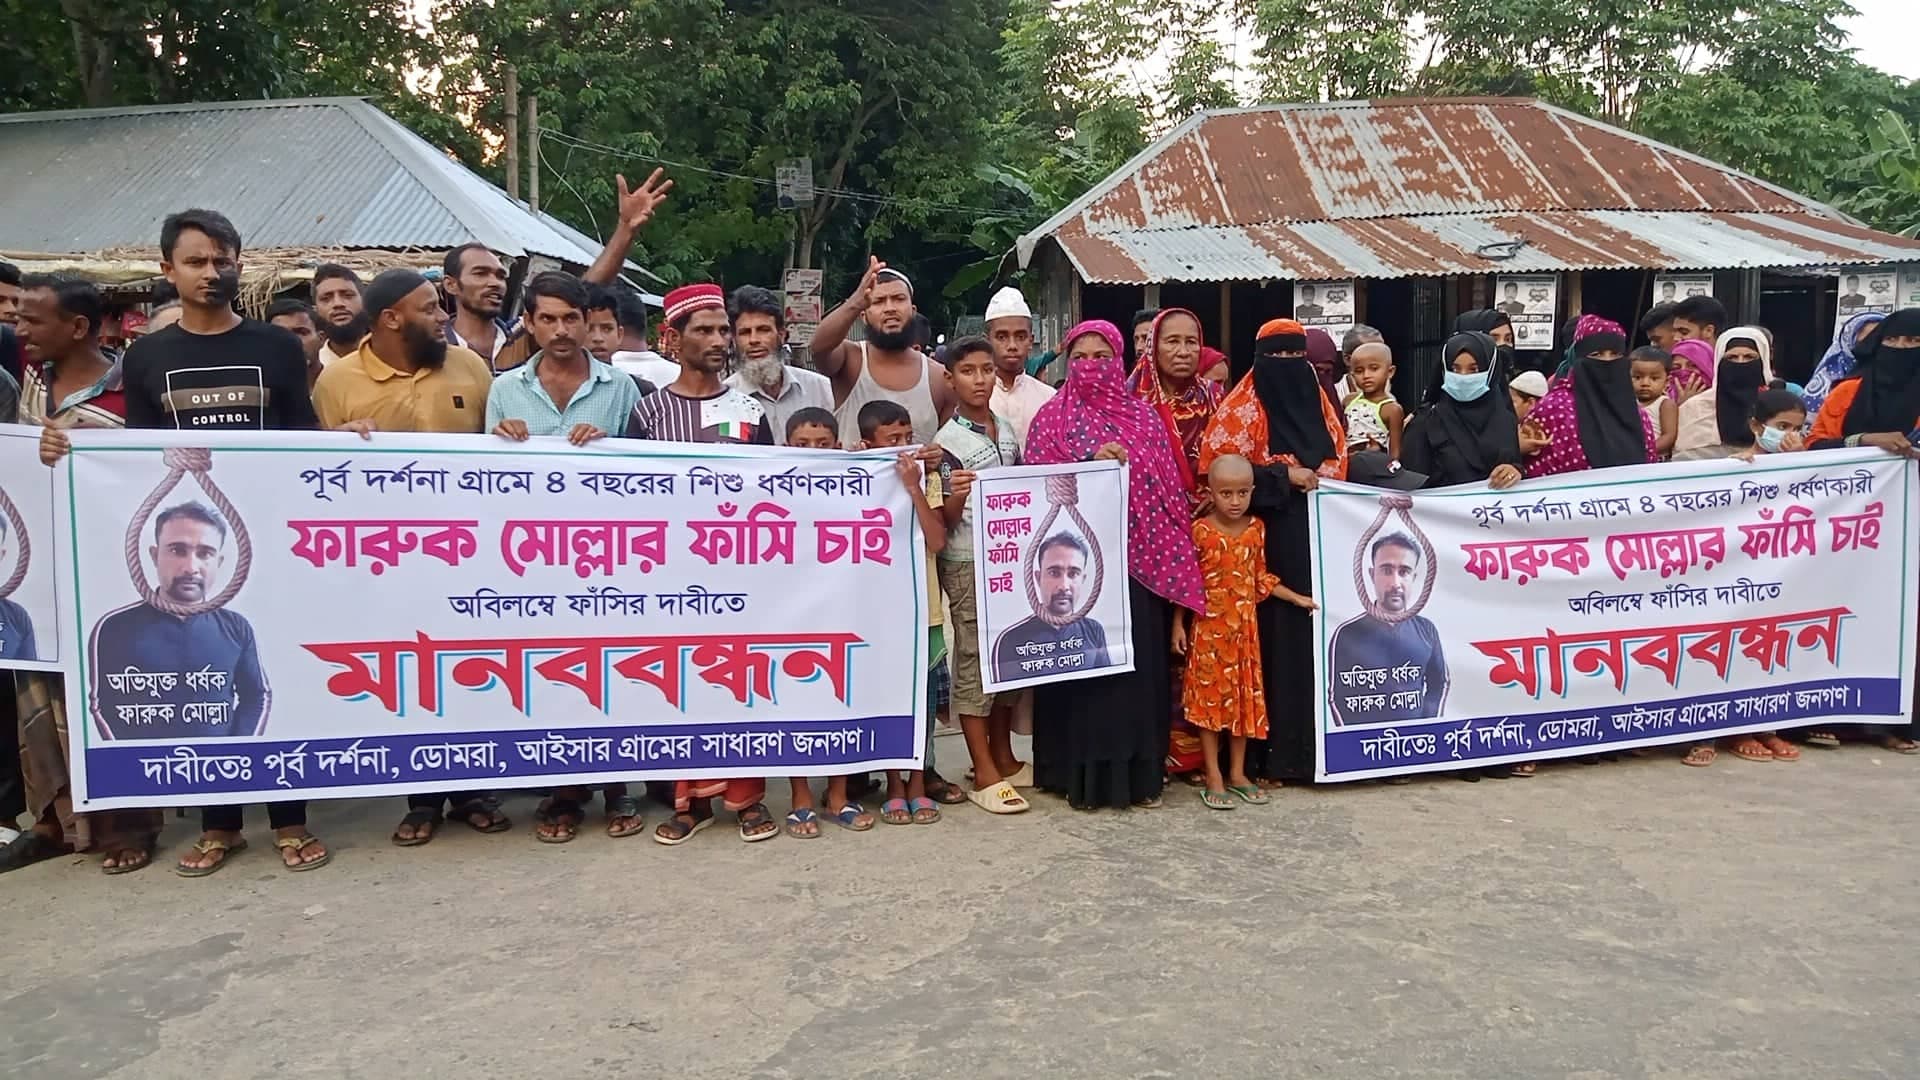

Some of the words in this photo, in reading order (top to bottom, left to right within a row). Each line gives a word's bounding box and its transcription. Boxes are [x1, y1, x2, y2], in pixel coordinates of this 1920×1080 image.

[191, 393, 221, 404] OUT
[227, 391, 245, 401] OF
[192, 413, 250, 425] CONTROL
[299, 460, 352, 502] পূর্ব
[360, 460, 451, 494] দর্শনা
[457, 468, 535, 495] গ্রামে
[546, 471, 566, 494] ৪
[577, 472, 677, 498] বছরের
[686, 465, 744, 496] শিশু
[757, 466, 874, 497] ধর্ষণকারী
[985, 491, 1031, 513] ফারুক
[1471, 499, 1505, 530] পূর্ব
[1511, 496, 1572, 524] দর্শনা
[1579, 497, 1632, 519] গ্রামে
[1639, 495, 1656, 514] ৪
[1660, 488, 1733, 513] বছরের
[1739, 480, 1780, 505] শিশু
[1787, 469, 1875, 500] ধর্ষণকারী
[287, 519, 479, 576] ফারুক
[500, 519, 669, 579] মোল্লার
[686, 501, 797, 565] ফাঁসি
[813, 507, 893, 566] চাই
[987, 516, 1032, 540] মোল্লার
[1460, 536, 1590, 586] ফারুক
[1605, 527, 1726, 581] মোল্লার
[1737, 505, 1817, 561] ফাঁসি
[1828, 501, 1884, 553] চাই
[987, 541, 1020, 565] ফাঁসি
[988, 571, 1013, 594] চাই
[1567, 590, 1644, 615] অবিলম্বে
[1649, 583, 1708, 609] ফাঁসির
[1713, 577, 1783, 604] দাবীতে
[447, 587, 557, 618] অবিলম্বে
[564, 586, 648, 617] ফাঁসির
[655, 584, 748, 616] দাবীতে
[1469, 605, 1858, 701] মানববন্ধন
[106, 665, 179, 698] অভিযুক্ত
[185, 663, 228, 692] ধর্ষক
[300, 630, 870, 718] মানববন্ধন
[1339, 664, 1388, 690] অভিযুক্ত
[1391, 660, 1422, 684] ধর্ষক
[115, 703, 177, 725] ফারুক
[182, 701, 230, 725] মোল্লা
[1344, 694, 1387, 713] ফারুক
[1390, 690, 1421, 710] মোল্লা
[1443, 721, 1473, 760] পূর্ব
[1611, 707, 1675, 734] আইসার
[1677, 700, 1730, 725] গ্রামের
[1733, 691, 1791, 718] সাধারণ
[263, 741, 309, 788] পূর্ব
[514, 731, 614, 765] আইসার
[617, 734, 695, 762] গ্রামের
[699, 729, 786, 758] সাধারণ
